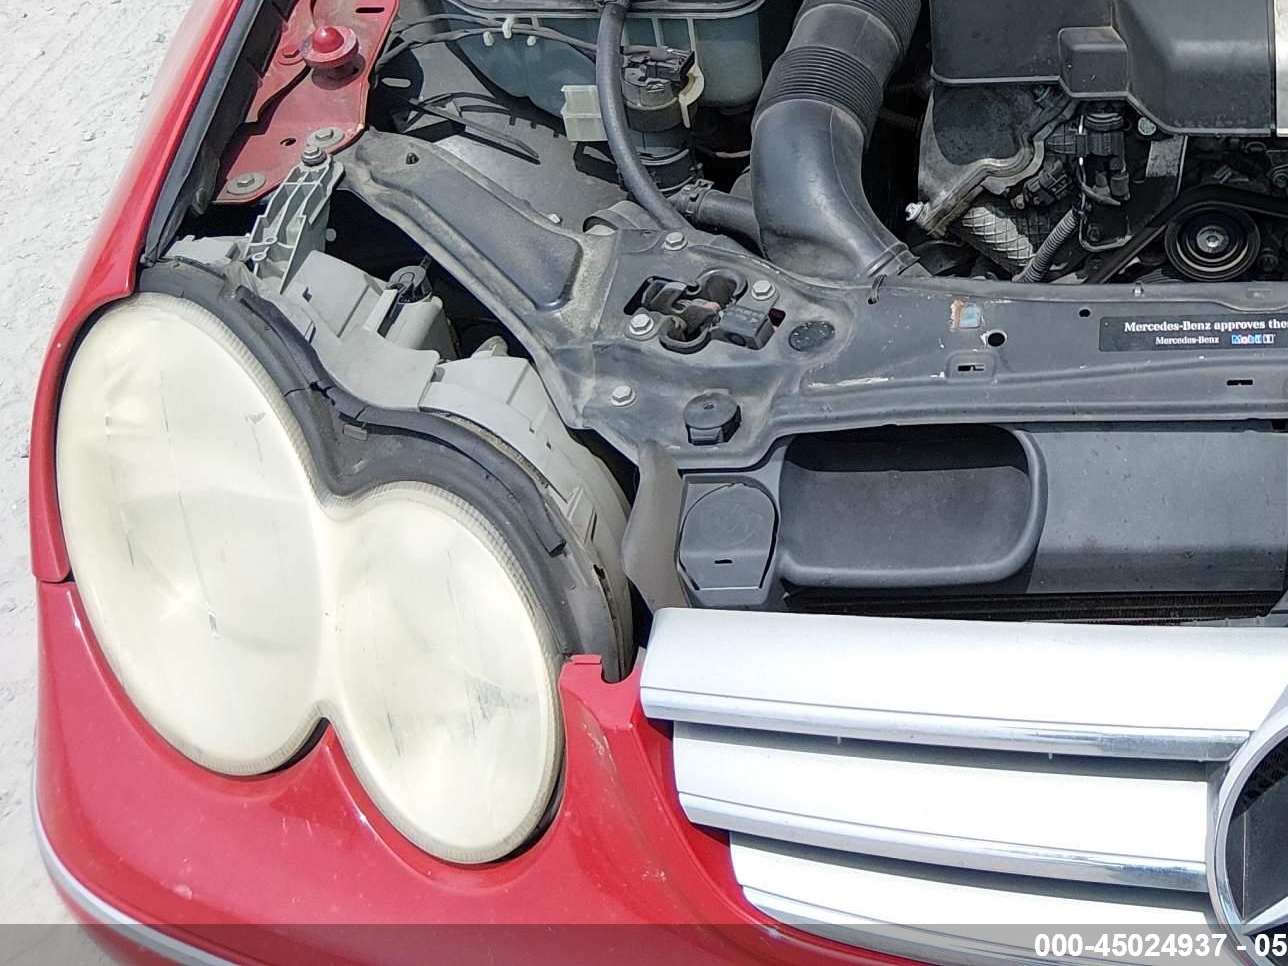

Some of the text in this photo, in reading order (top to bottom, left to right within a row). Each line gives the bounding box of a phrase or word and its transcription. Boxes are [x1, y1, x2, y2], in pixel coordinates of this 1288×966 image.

[1124, 322, 1211, 332] Mercedes-Benz
[1214, 321, 1266, 333] approves
[1155, 336, 1219, 346] Mercedes-Benz
